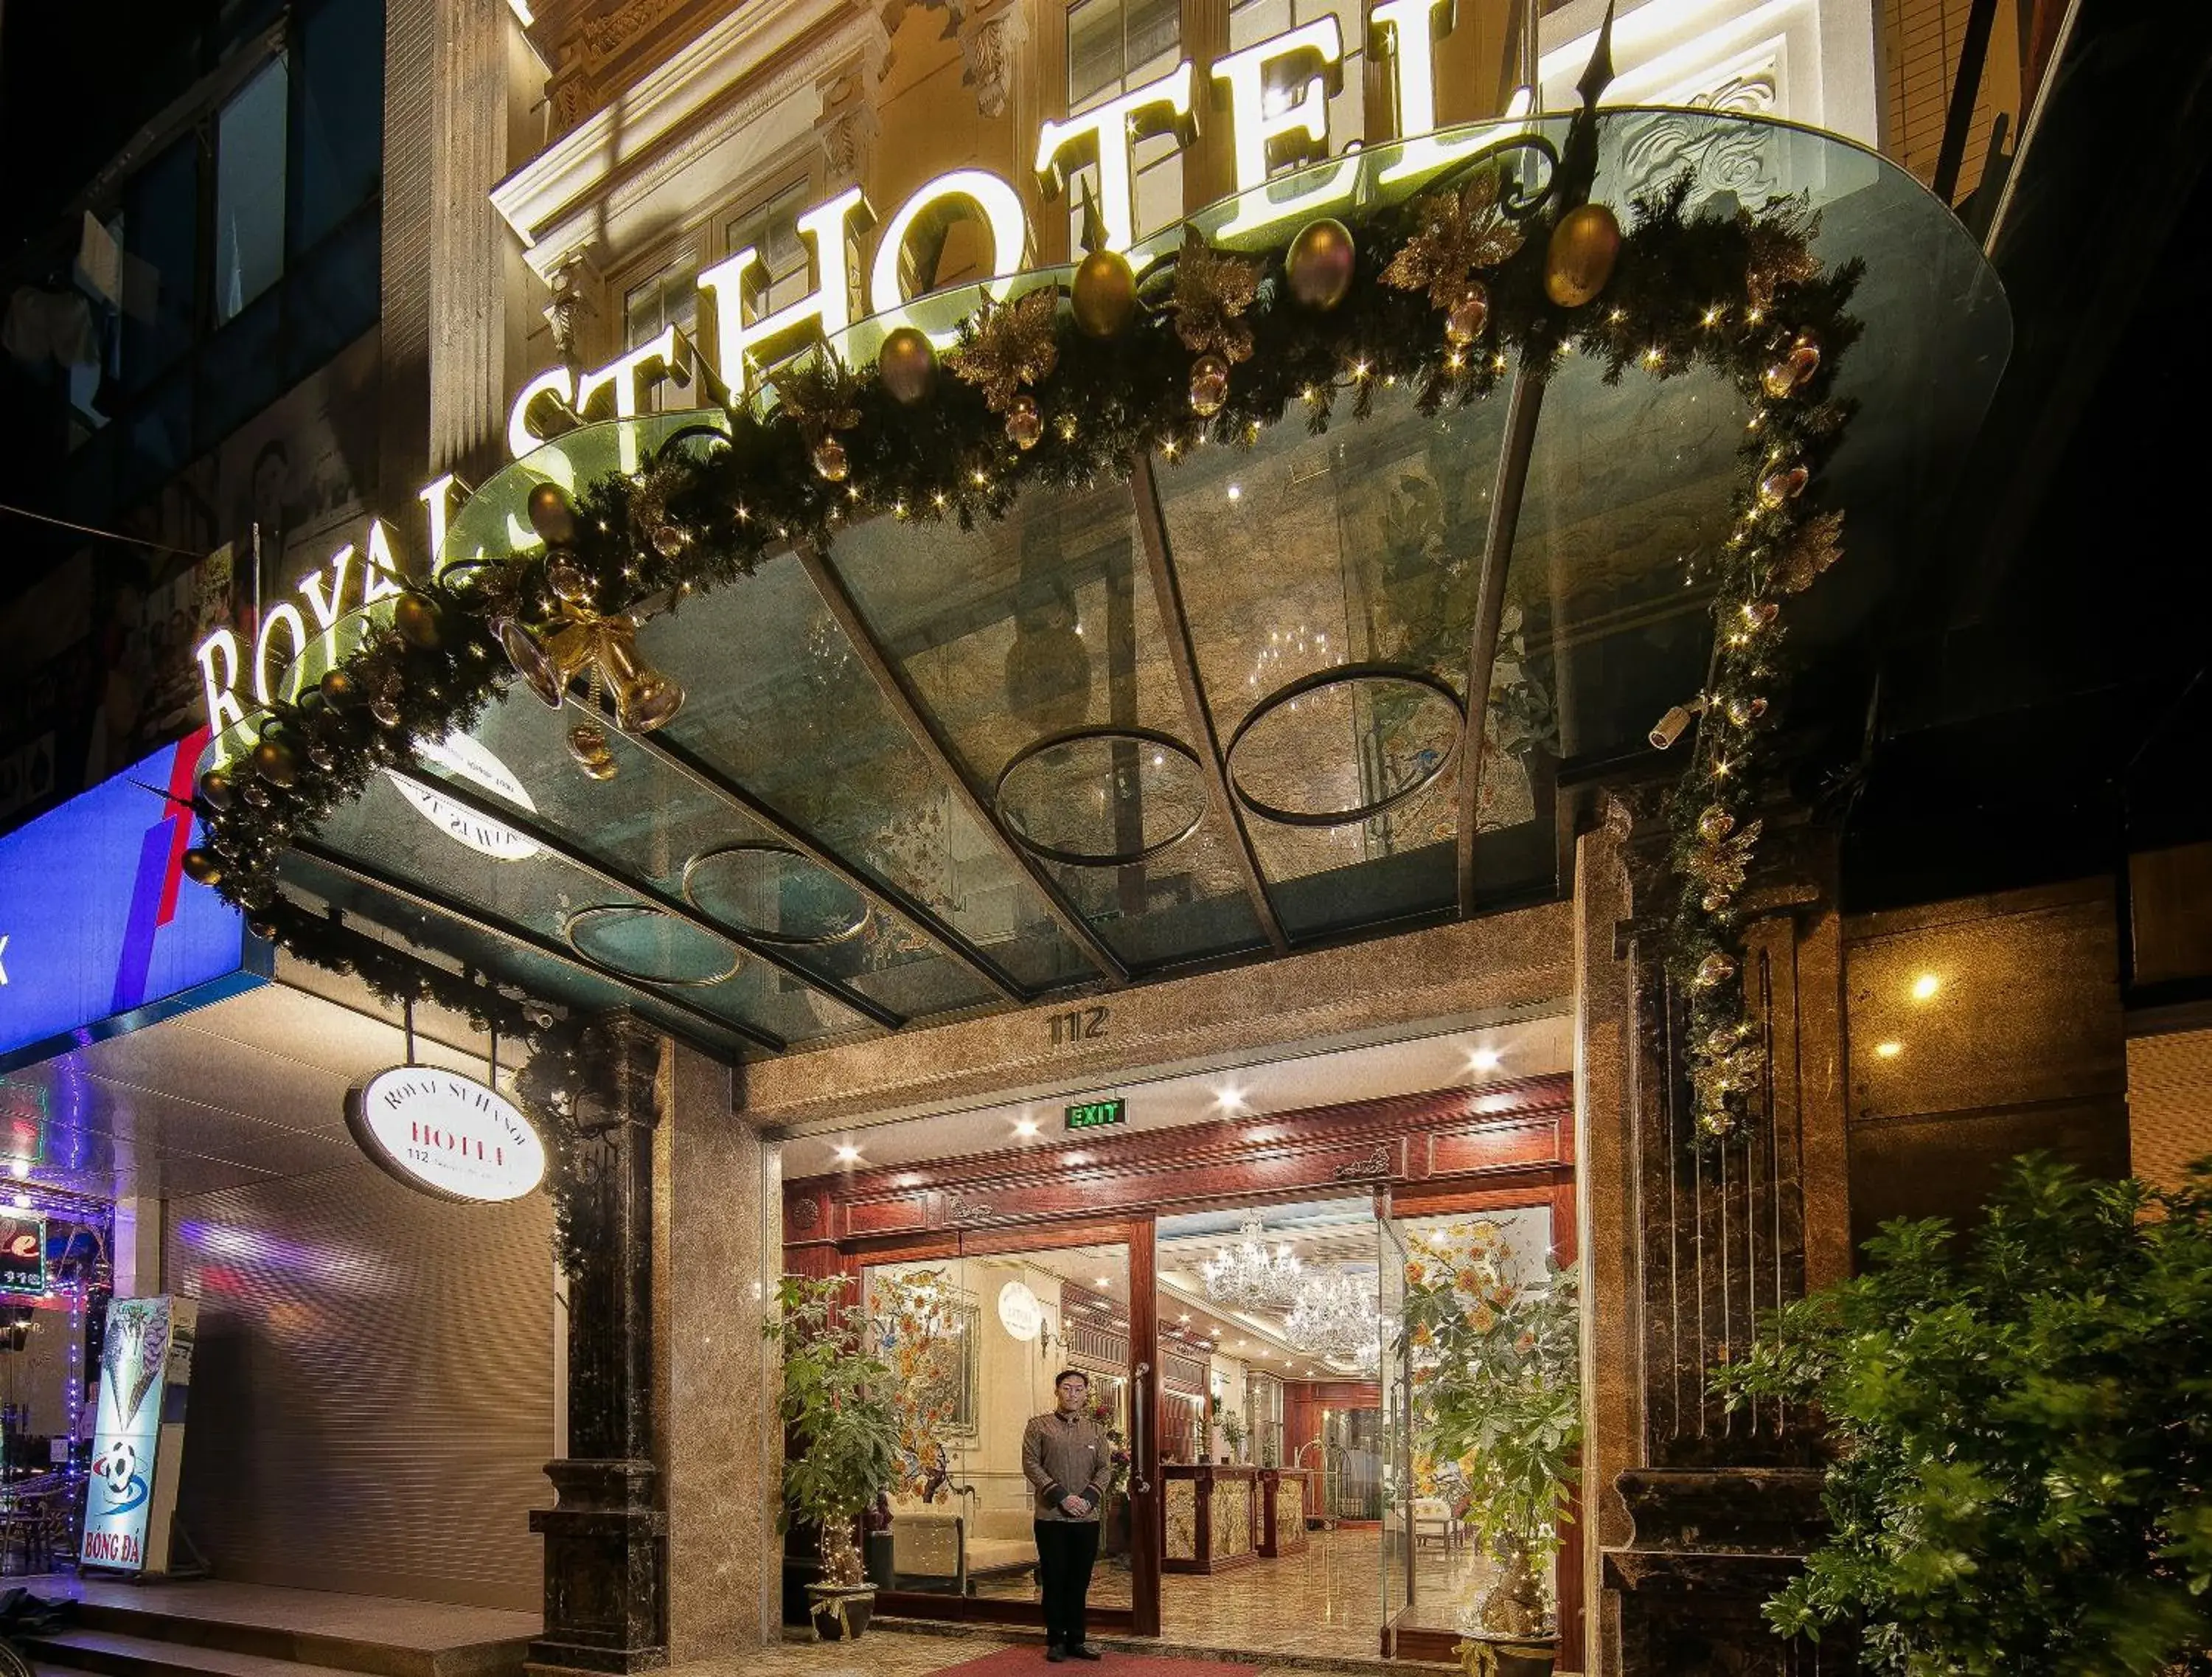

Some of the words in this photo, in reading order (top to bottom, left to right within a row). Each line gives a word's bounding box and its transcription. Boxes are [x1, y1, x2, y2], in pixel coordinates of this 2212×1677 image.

[196, 472, 483, 771] ROYAL
[507, 323, 674, 550] ST
[697, 0, 1532, 409] HOTEL
[1047, 1006, 1110, 1046] 112
[1071, 1104, 1119, 1127] EXIT
[407, 1147, 429, 1164] 112
